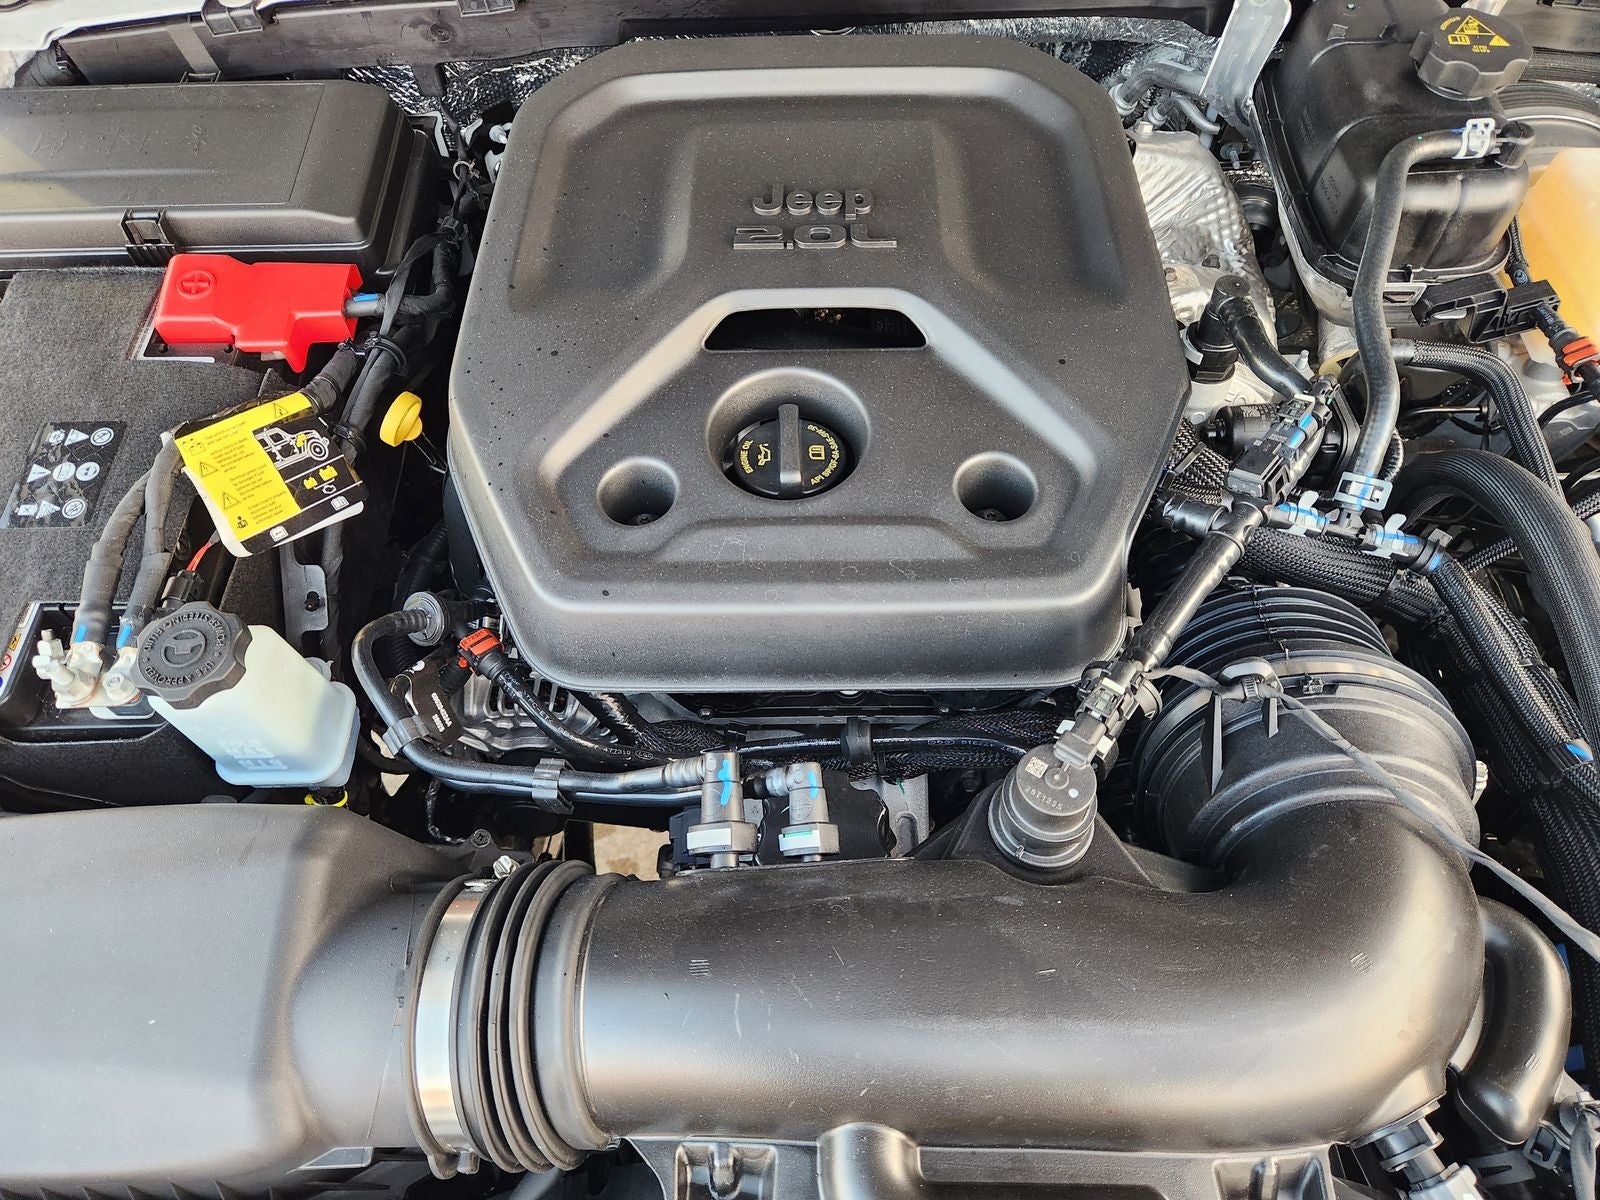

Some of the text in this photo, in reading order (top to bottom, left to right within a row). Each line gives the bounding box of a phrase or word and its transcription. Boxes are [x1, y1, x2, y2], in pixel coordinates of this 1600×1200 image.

[752, 183, 874, 221] Jeep
[733, 223, 898, 250] 2.0L
[740, 439, 754, 475] ENGINE OIL
[810, 474, 825, 486] API
[143, 611, 227, 652] POWER STEERING FLUID
[145, 660, 217, 686] USE APPROVED
